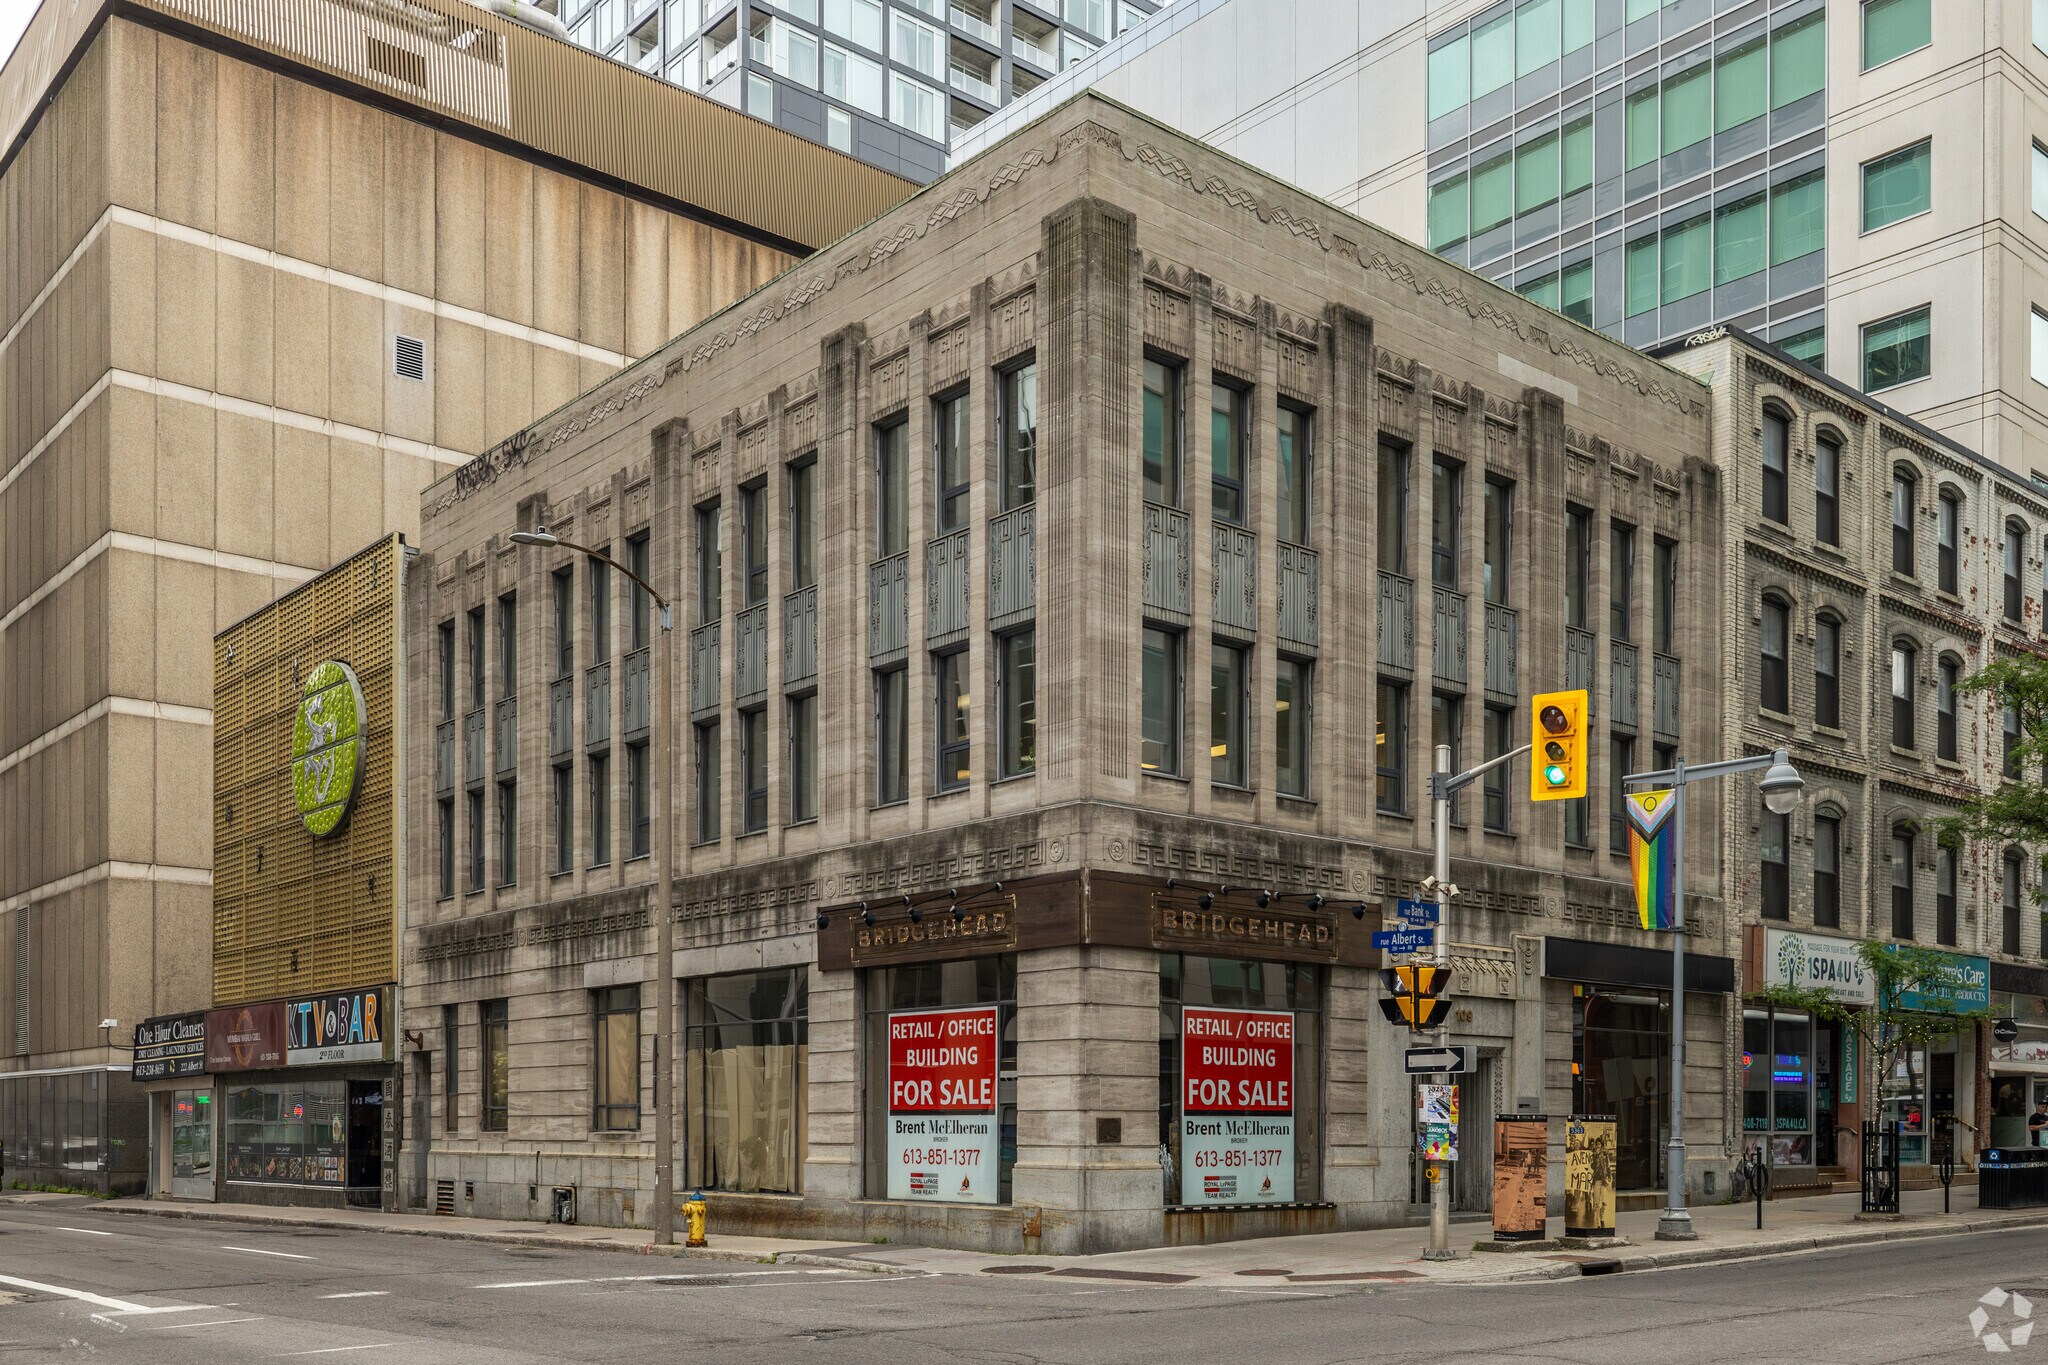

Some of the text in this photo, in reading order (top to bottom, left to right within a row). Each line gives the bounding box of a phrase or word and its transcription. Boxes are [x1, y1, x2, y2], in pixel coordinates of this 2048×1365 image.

[1412, 904, 1424, 916] Bank
[858, 911, 1007, 948] BRIDGEHEAD
[1163, 908, 1329, 944] BRIDGEHEAD
[1392, 933, 1416, 944] Albert
[1808, 956, 1852, 984] 1SPA4U
[1964, 966, 1986, 987] Care
[288, 1000, 326, 1048] KTV
[338, 993, 379, 1044] BAR
[1456, 1010, 1473, 1022] 109
[139, 1020, 204, 1044] One Hour Cleaners
[893, 1018, 993, 1040] RETAIL / OFFICE
[1187, 1018, 1290, 1038] RETAIL / OFFICE
[138, 1050, 146, 1058] DRY
[187, 1042, 204, 1052] SERVICES
[328, 1050, 345, 1059] FLOOR
[907, 1046, 978, 1067] BUILDING
[1203, 1046, 1276, 1067] BUILDING
[188, 1061, 199, 1071] Albert
[894, 1078, 991, 1106] FOR SALE
[1188, 1079, 1288, 1106] FOR SALE
[896, 1120, 987, 1134] Brent McElheran
[1186, 1120, 1290, 1135] Brent McElheran
[903, 1149, 980, 1166] 613-851-1377
[1195, 1150, 1282, 1167] 613-851-1377
